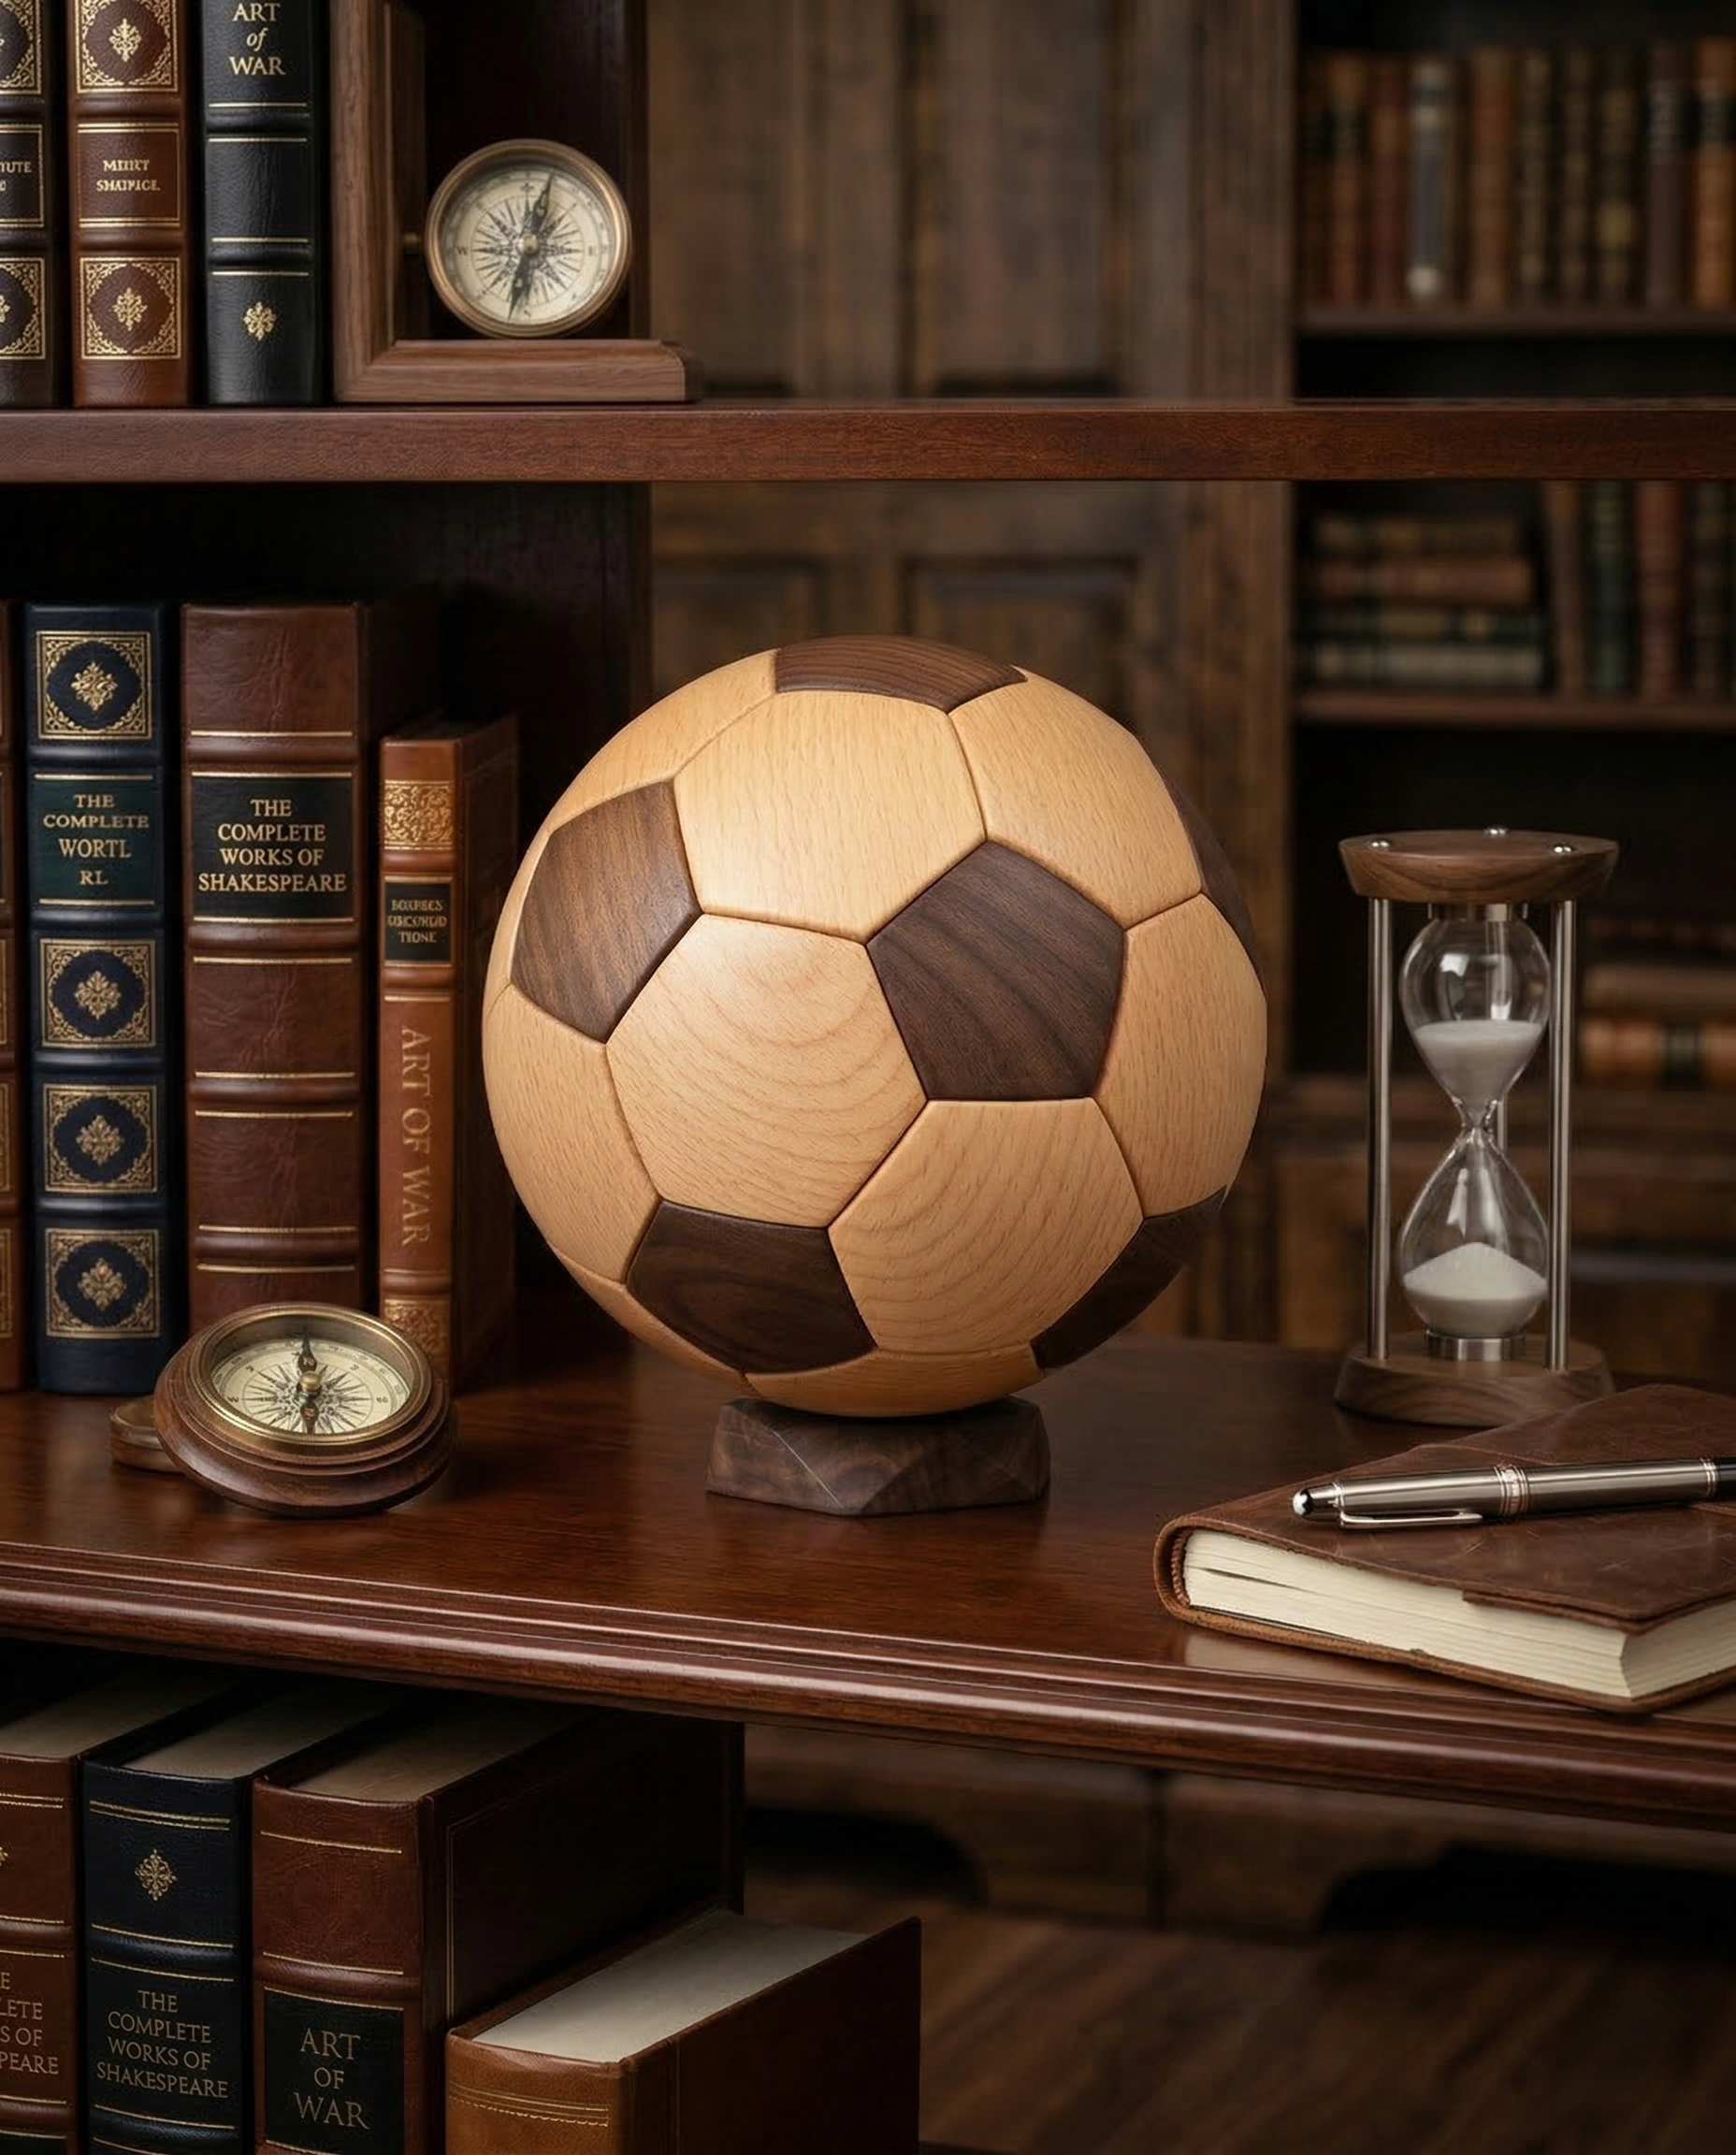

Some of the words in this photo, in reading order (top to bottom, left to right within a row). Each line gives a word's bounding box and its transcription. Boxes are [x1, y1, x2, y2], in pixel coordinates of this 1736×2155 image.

[231, 3, 281, 22] ART
[246, 27, 268, 51] of
[228, 56, 286, 76] WAR
[73, 793, 115, 808] THE
[250, 799, 293, 817] THE
[43, 814, 150, 829] COMPLETE
[217, 823, 326, 842] COMPLETE
[58, 838, 132, 859] WORTL
[219, 848, 294, 866] WORKS
[297, 848, 325, 866] OF
[80, 870, 108, 885] RL
[197, 873, 348, 892] SHAKESPEARE
[401, 1025, 432, 1097] ART
[401, 1107, 431, 1154] OF
[401, 1165, 431, 1248] WAR
[137, 1989, 179, 2013] THE
[15, 2027, 43, 2047] OF
[108, 2010, 212, 2044] COMPLETE
[107, 2035, 179, 2067] WORKS
[183, 2050, 211, 2071] OF
[299, 2027, 362, 2061] ART
[96, 2061, 229, 2099] SHAKESPEARE
[313, 2066, 345, 2090] OF
[293, 2091, 371, 2131] WAR
